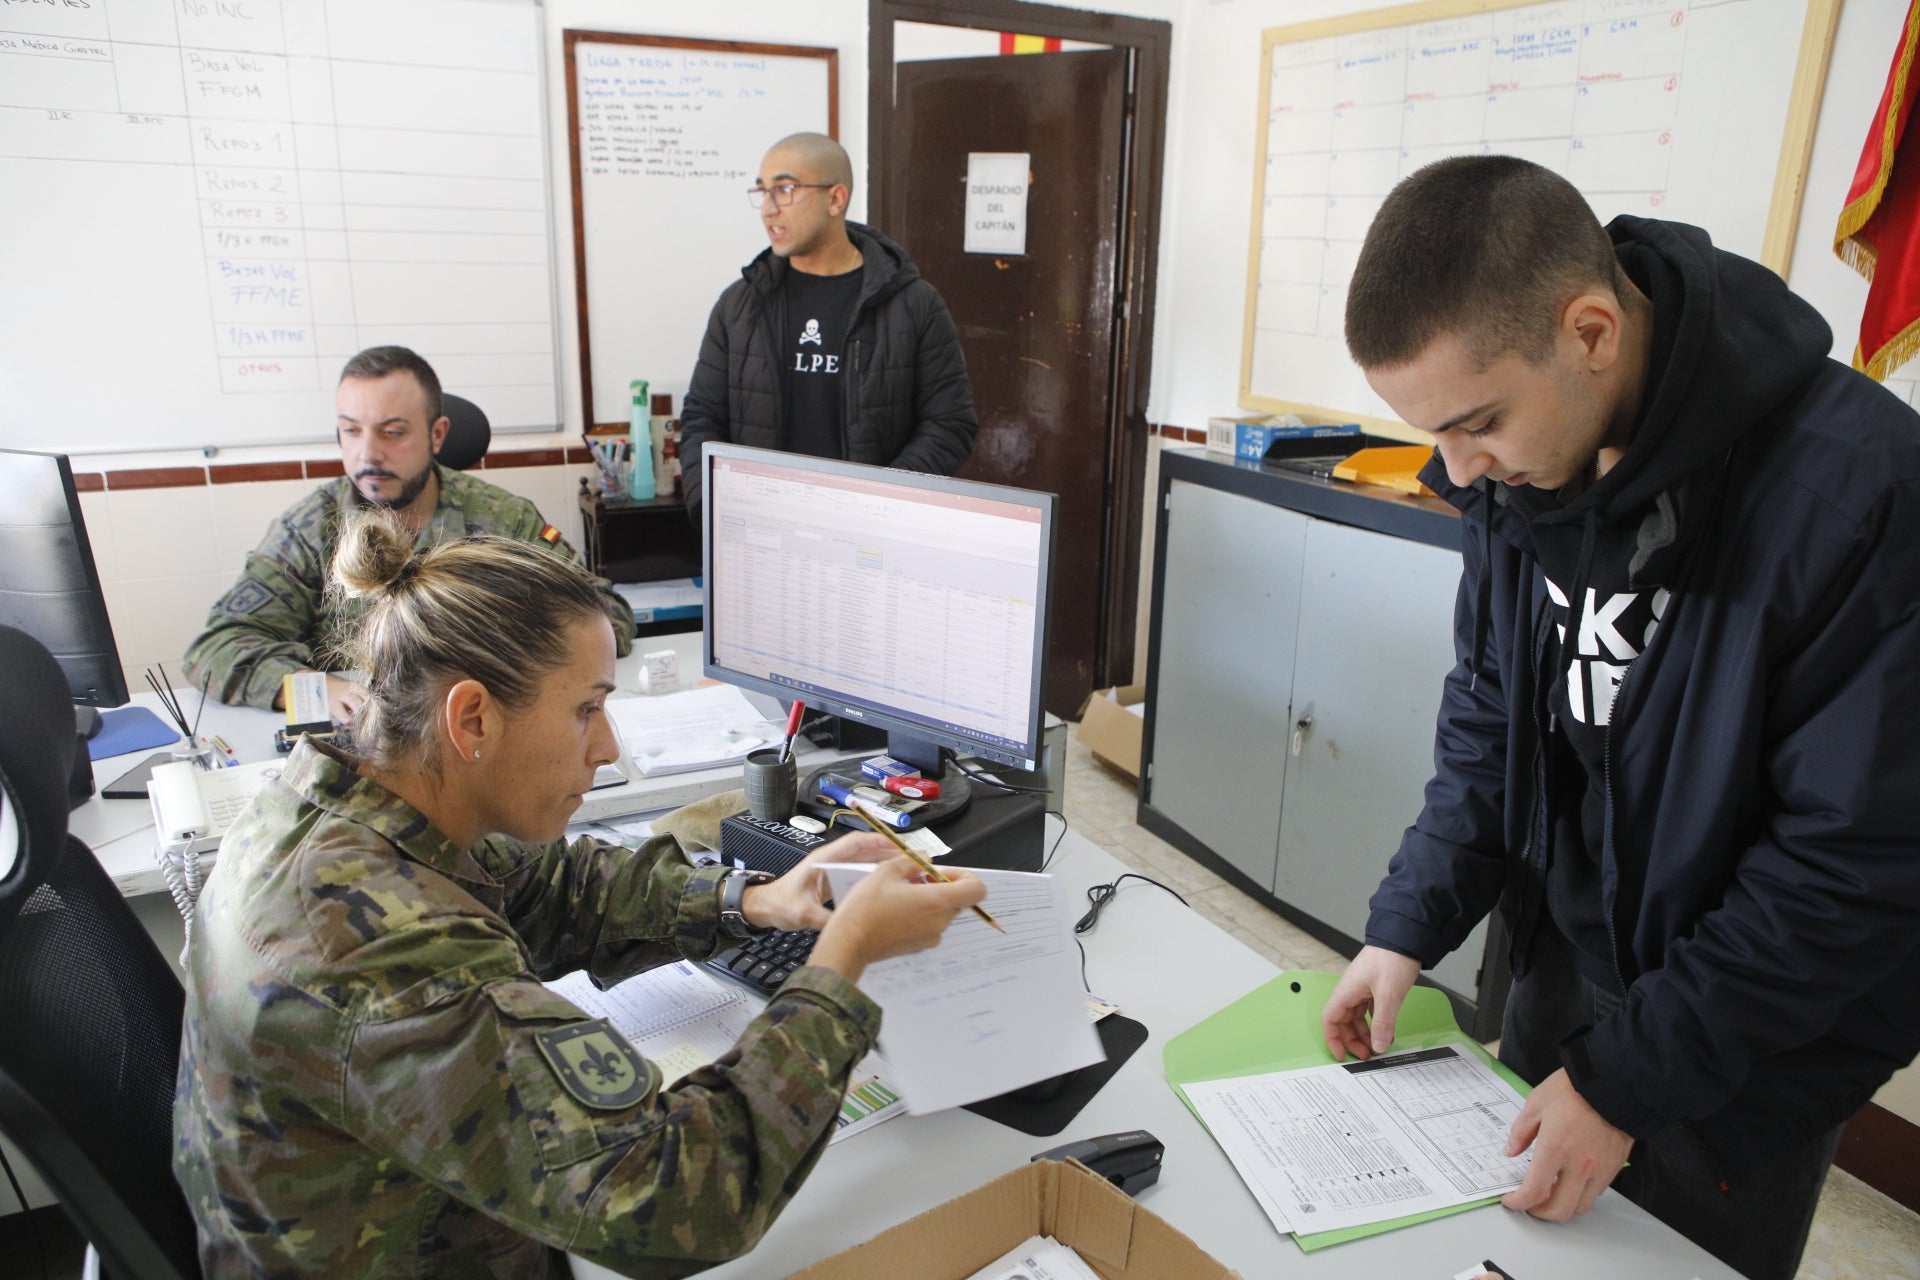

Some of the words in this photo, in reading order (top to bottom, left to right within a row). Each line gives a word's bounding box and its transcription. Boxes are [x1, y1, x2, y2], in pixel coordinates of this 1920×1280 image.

[273, 132, 283, 153] 1
[269, 175, 288, 194] 2
[972, 184, 1023, 196] DESPACHO
[274, 205, 288, 224] 3
[986, 203, 1005, 213] DEL
[229, 285, 305, 307] FFME
[271, 328, 306, 344] FFME
[795, 352, 840, 374] LPE
[1247, 444, 1264, 458] A4
[845, 707, 864, 718] PHILIPS
